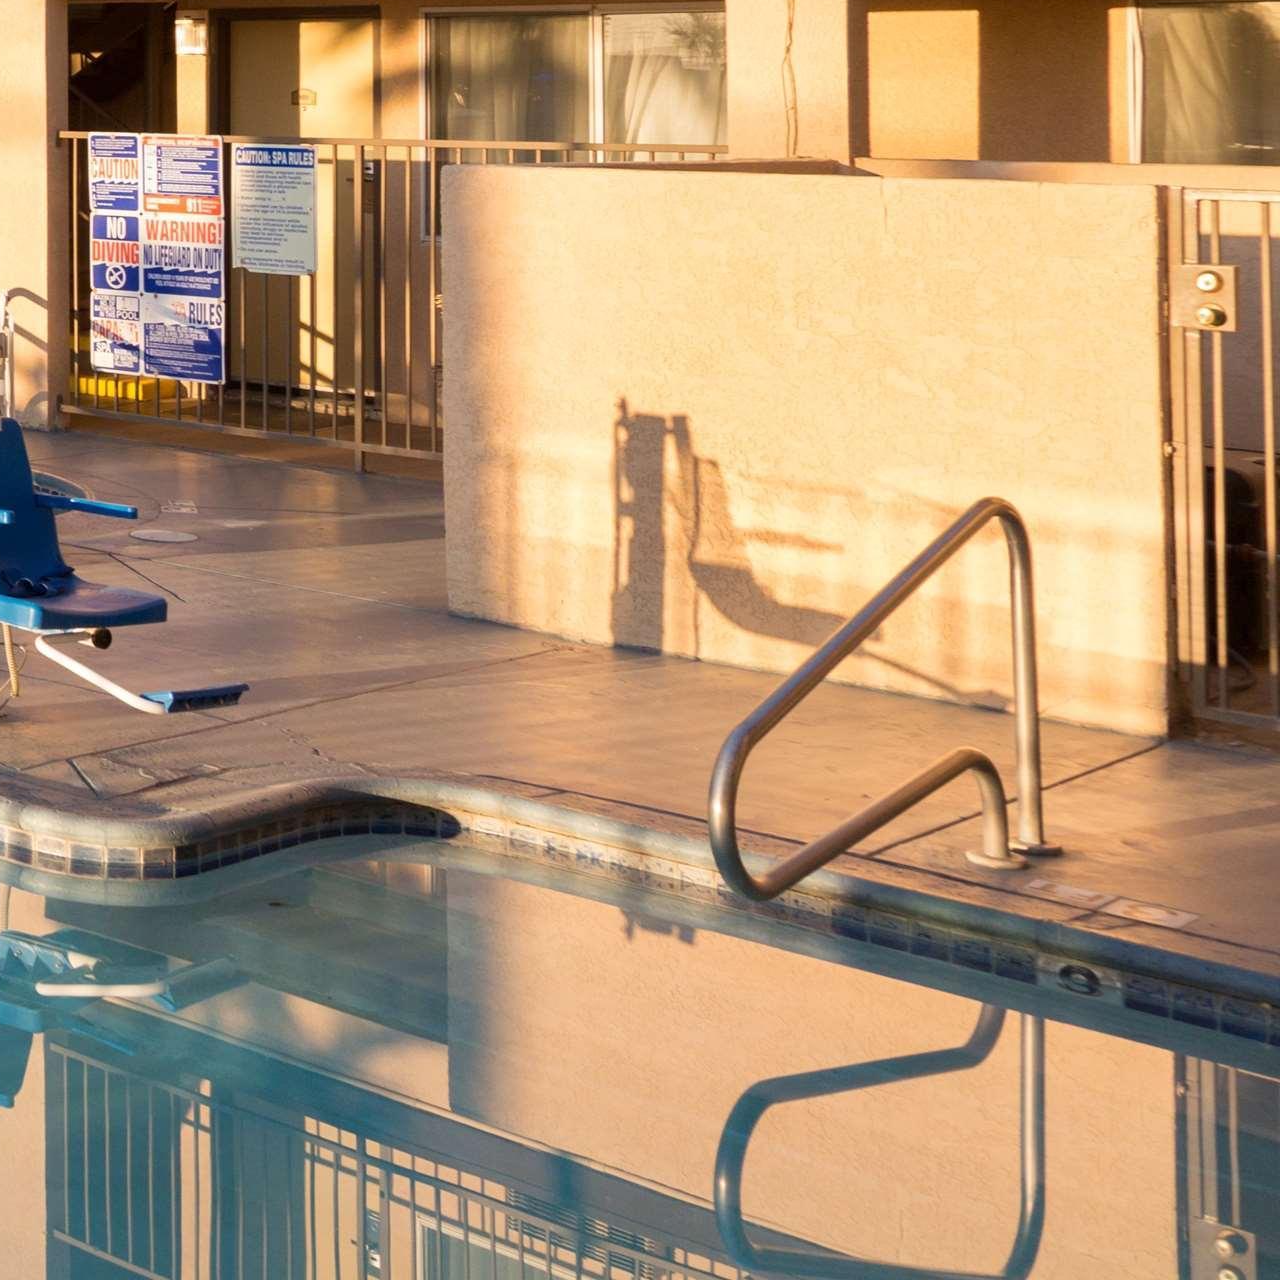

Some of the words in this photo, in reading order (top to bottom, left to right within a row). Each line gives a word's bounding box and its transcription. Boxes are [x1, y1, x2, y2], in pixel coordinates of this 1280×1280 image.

[91, 157, 138, 180] CAUTION
[272, 151, 288, 165] SPA
[288, 152, 314, 166] RULES
[106, 216, 127, 239] NO
[145, 218, 223, 245] WARNING!
[92, 240, 139, 264] DIVING
[144, 244, 153, 266] NO
[154, 245, 191, 268] LIFEGUARD
[193, 248, 203, 269] ON
[205, 248, 223, 270] DUTY
[116, 311, 140, 321] POOL
[188, 302, 223, 326] RULES
[96, 341, 112, 353] SPA
